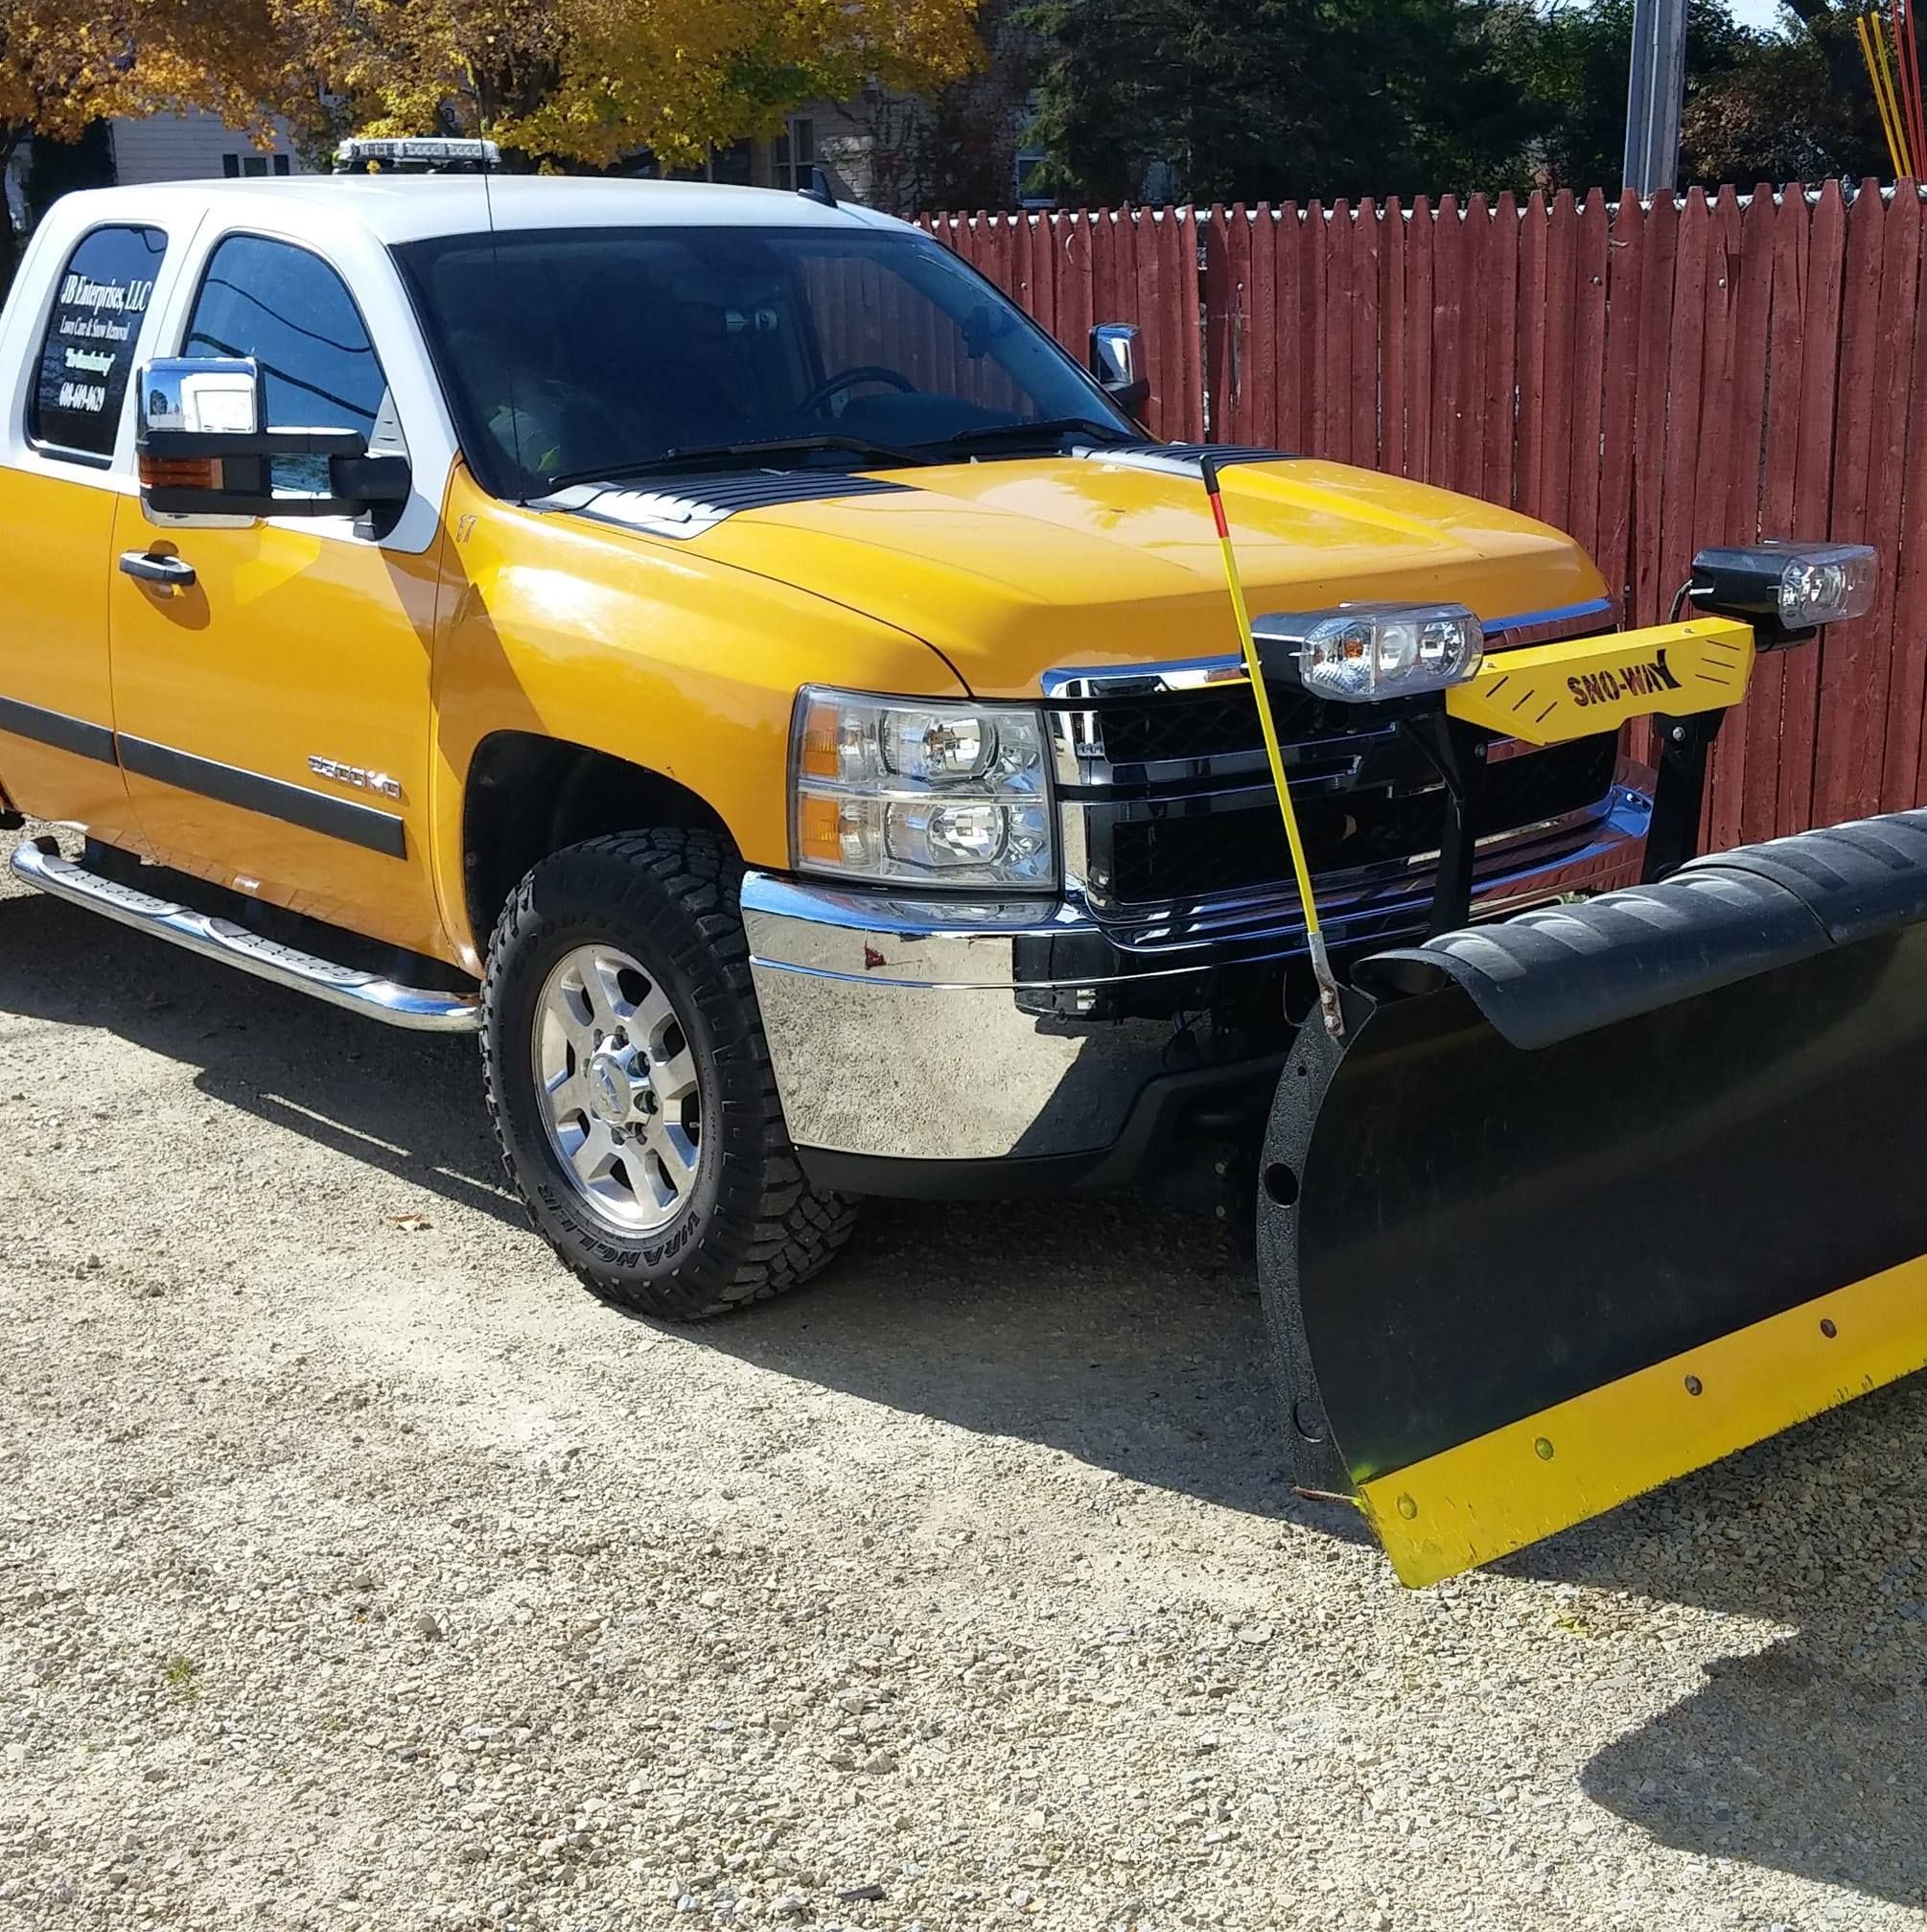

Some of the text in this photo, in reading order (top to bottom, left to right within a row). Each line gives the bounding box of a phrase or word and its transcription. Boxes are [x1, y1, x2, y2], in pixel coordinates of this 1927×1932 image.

[60, 275, 152, 315] JB Enterprises, LLC
[1567, 649, 1683, 707] SNO-WAY
[538, 1182, 701, 1269] WRANGLER
